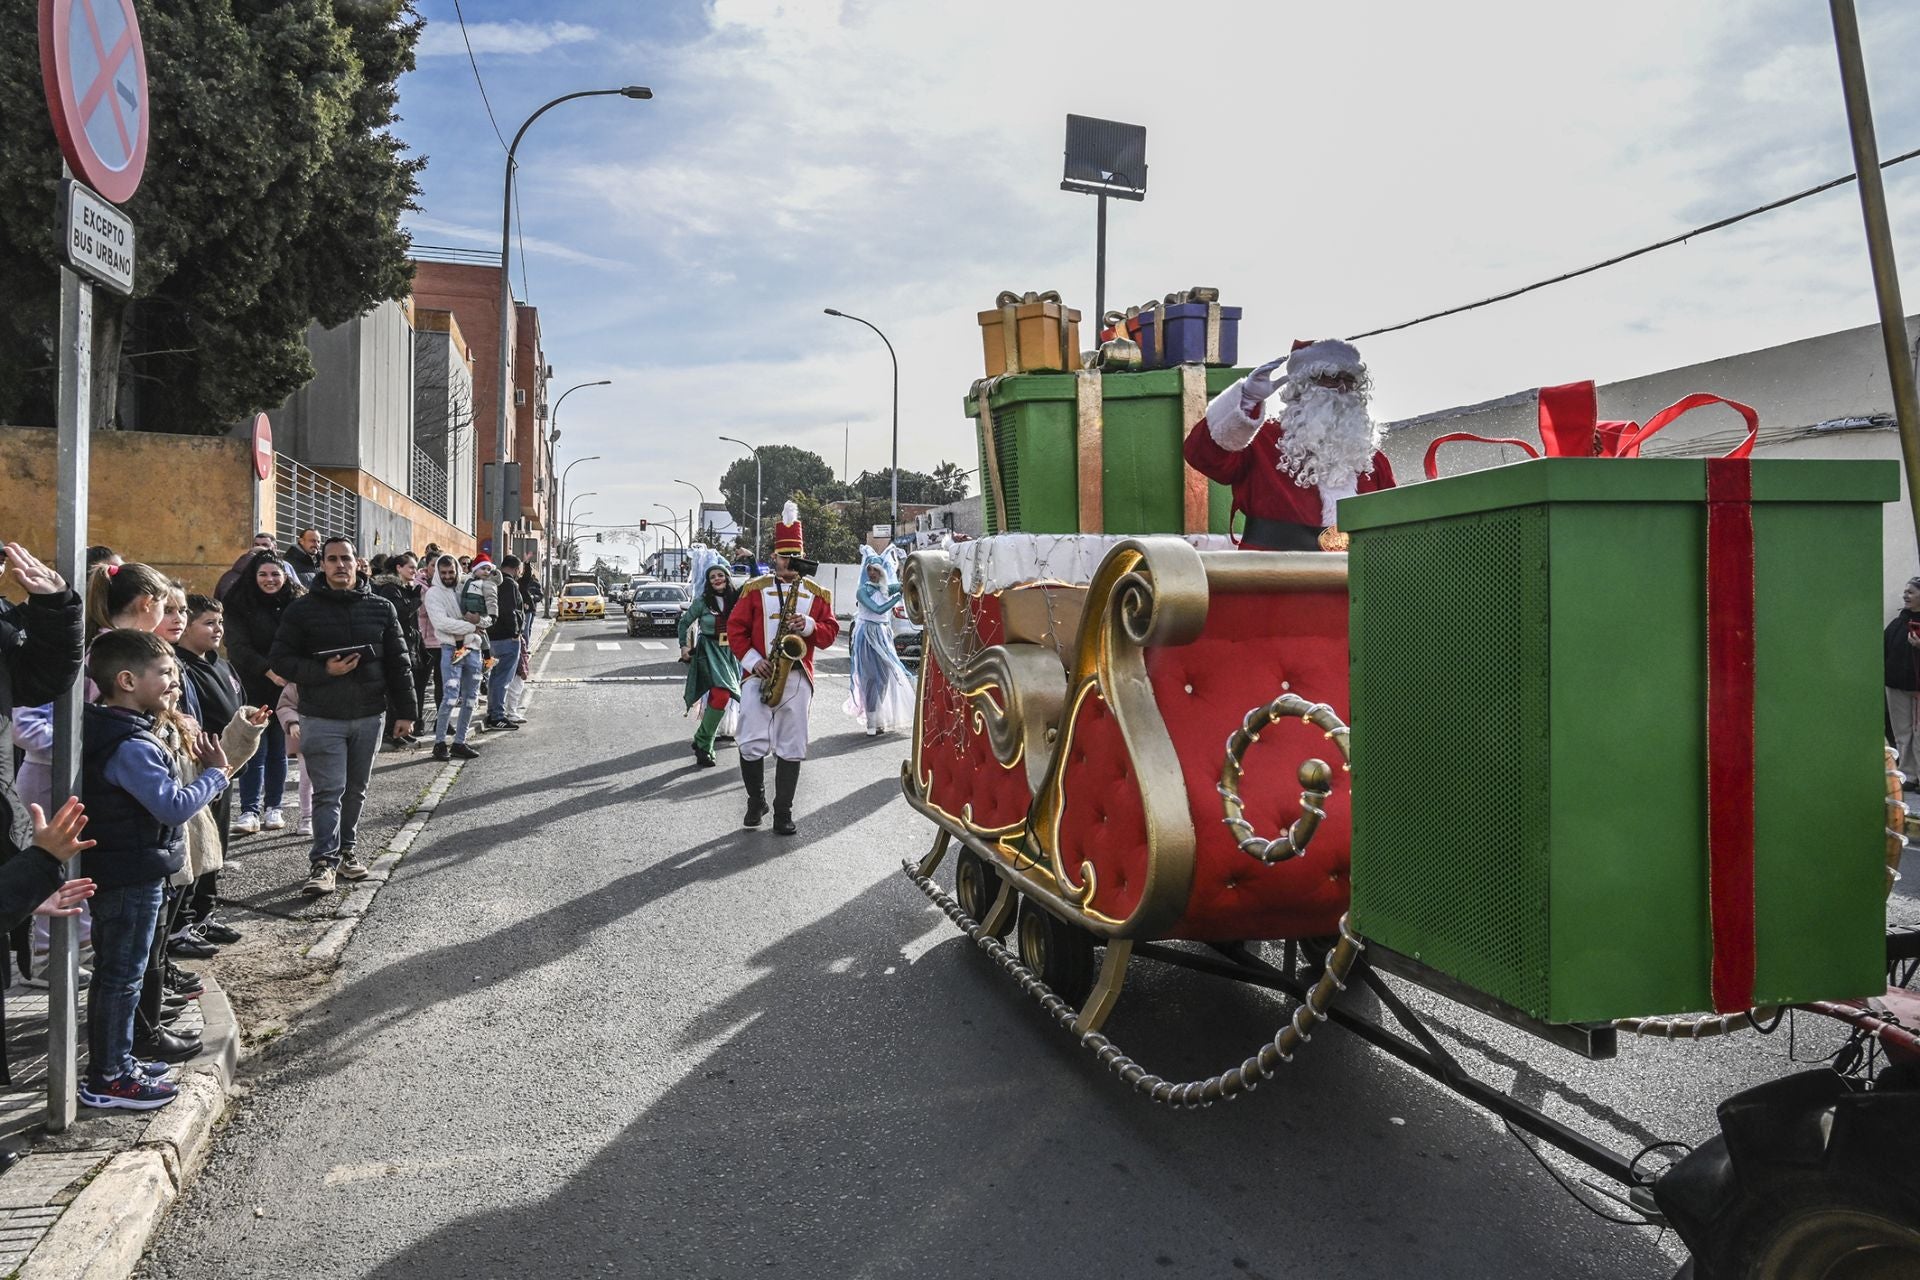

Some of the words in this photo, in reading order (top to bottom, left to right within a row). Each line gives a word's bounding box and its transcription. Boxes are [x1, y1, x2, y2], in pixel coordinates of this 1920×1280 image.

[83, 206, 124, 246] EXCEPTO
[73, 228, 93, 254] BUS
[96, 241, 131, 276] URBANO
